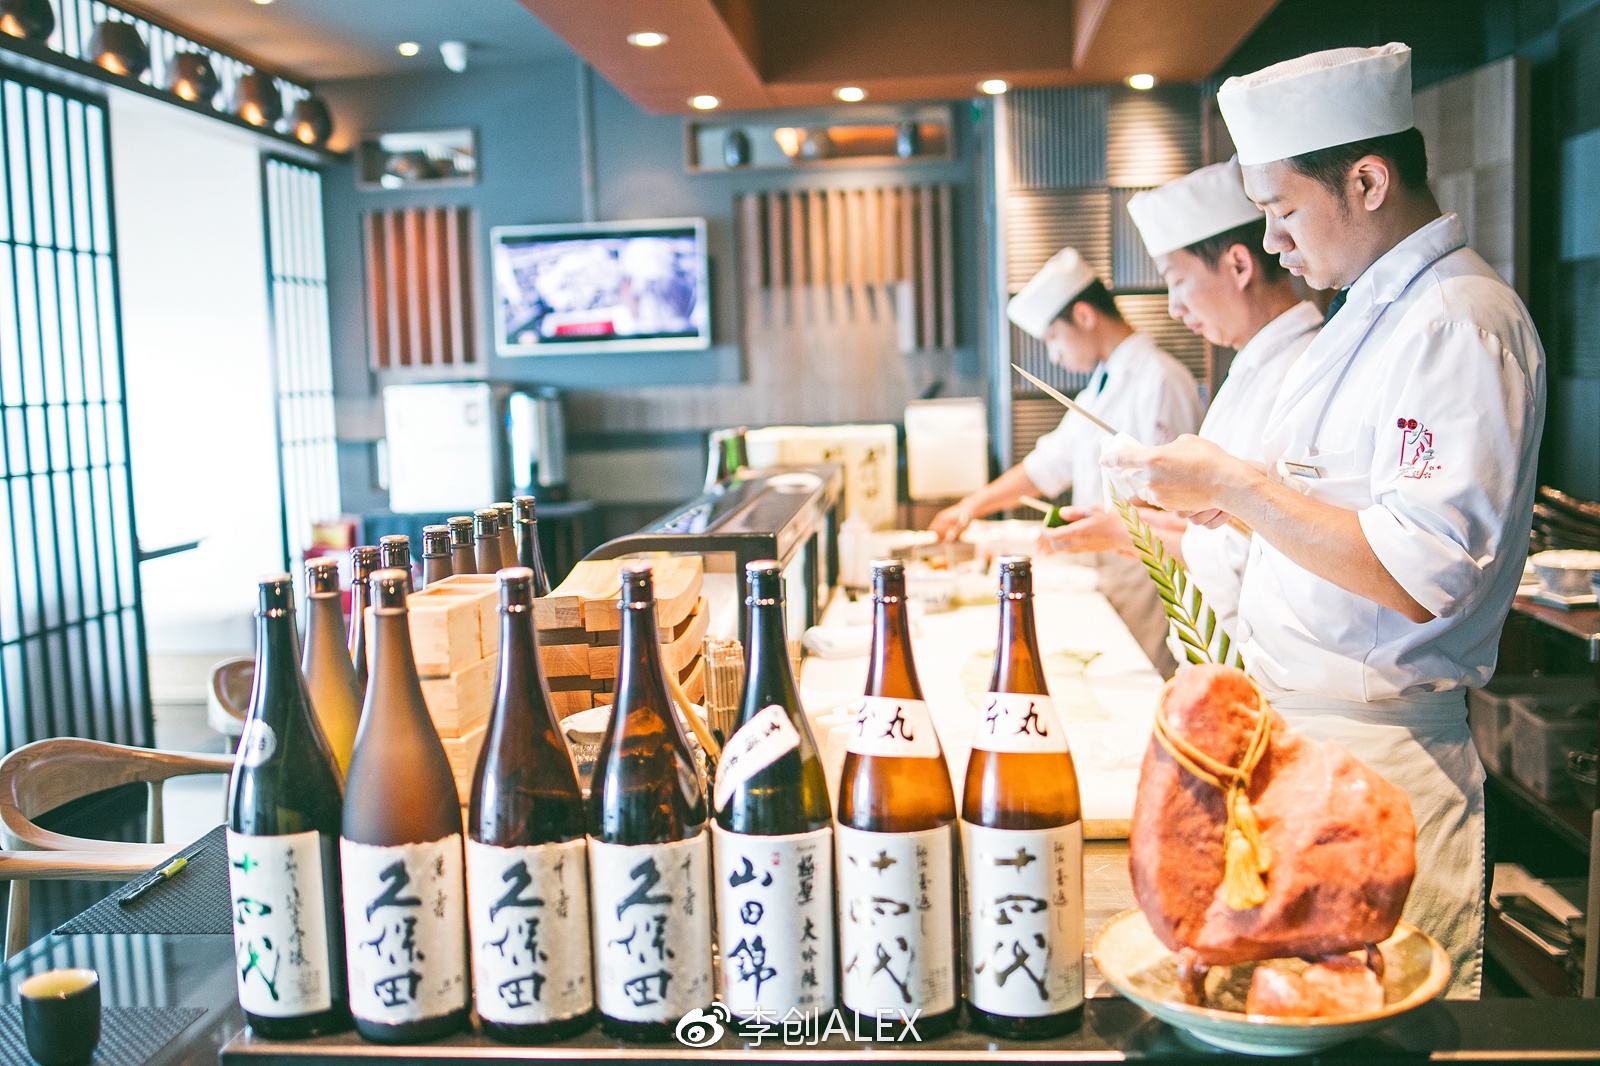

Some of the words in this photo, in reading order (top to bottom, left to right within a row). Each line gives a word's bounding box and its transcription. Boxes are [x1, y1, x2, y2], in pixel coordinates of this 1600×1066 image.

[359, 859, 425, 1008] 久保田
[482, 859, 548, 1009] 久保田
[608, 857, 675, 1007] 久保田
[728, 856, 777, 1002] 山田錦
[846, 850, 912, 1004] 十四代
[975, 846, 1049, 1001] 十四代
